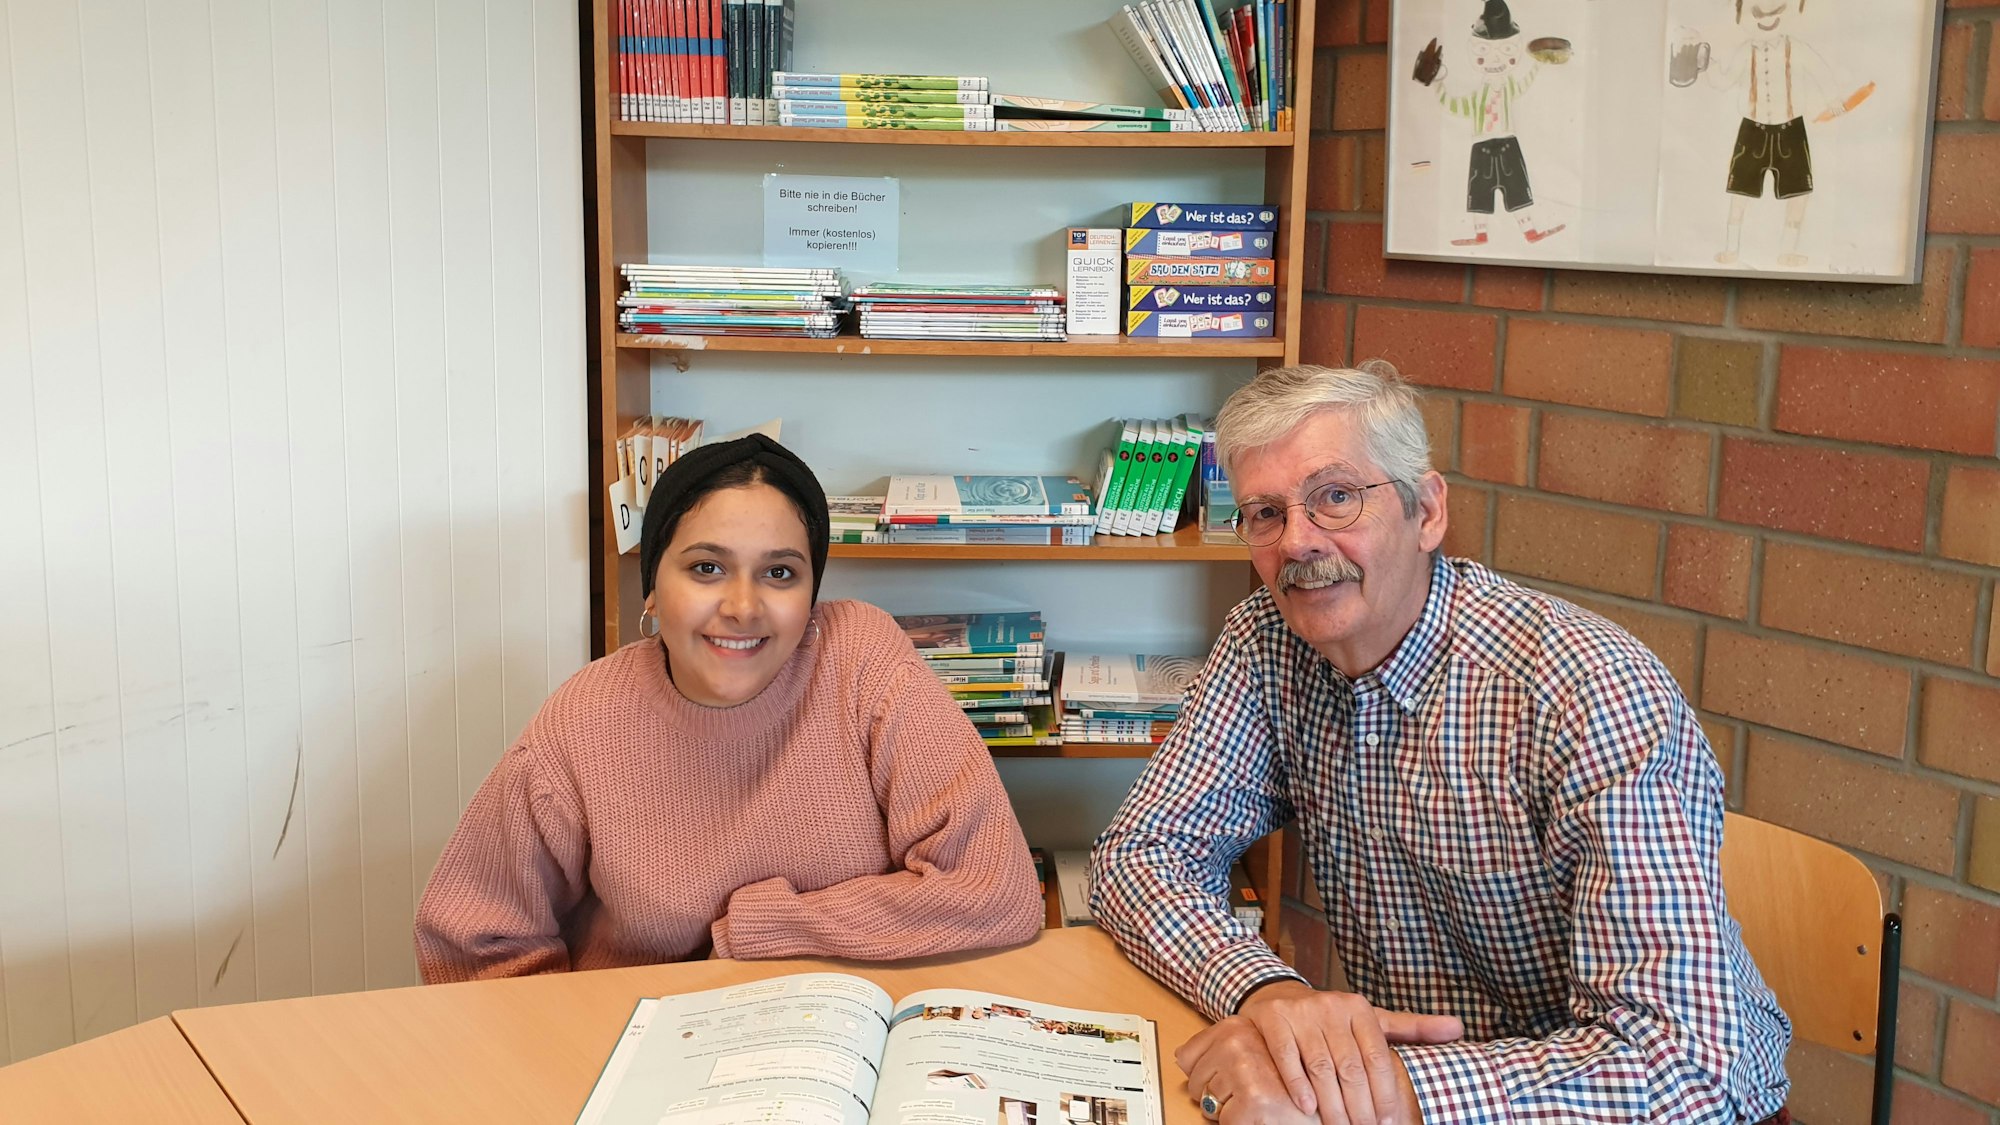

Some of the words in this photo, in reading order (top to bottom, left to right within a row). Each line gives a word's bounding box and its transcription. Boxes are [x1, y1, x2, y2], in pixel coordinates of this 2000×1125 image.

[779, 188, 802, 199] Bitte
[804, 190, 819, 200] nie
[822, 190, 831, 200] in
[833, 191, 848, 200] die
[851, 191, 886, 202] Bücher
[807, 203, 857, 213] schreiben!
[1185, 210, 1207, 222] Wer
[1210, 211, 1225, 223] ist
[1226, 212, 1254, 225] das?
[789, 227, 820, 237] Immer
[822, 228, 876, 240] (kostenlos)
[806, 240, 857, 251] kopieren!!!
[1073, 257, 1115, 265] QUICK
[1171, 264, 1190, 275] DEN
[1192, 265, 1219, 275] SATZ!
[1183, 293, 1205, 305] Wer
[1207, 293, 1222, 305] ist
[1224, 293, 1252, 306] das?
[639, 456, 648, 486] C
[620, 503, 630, 530] D
